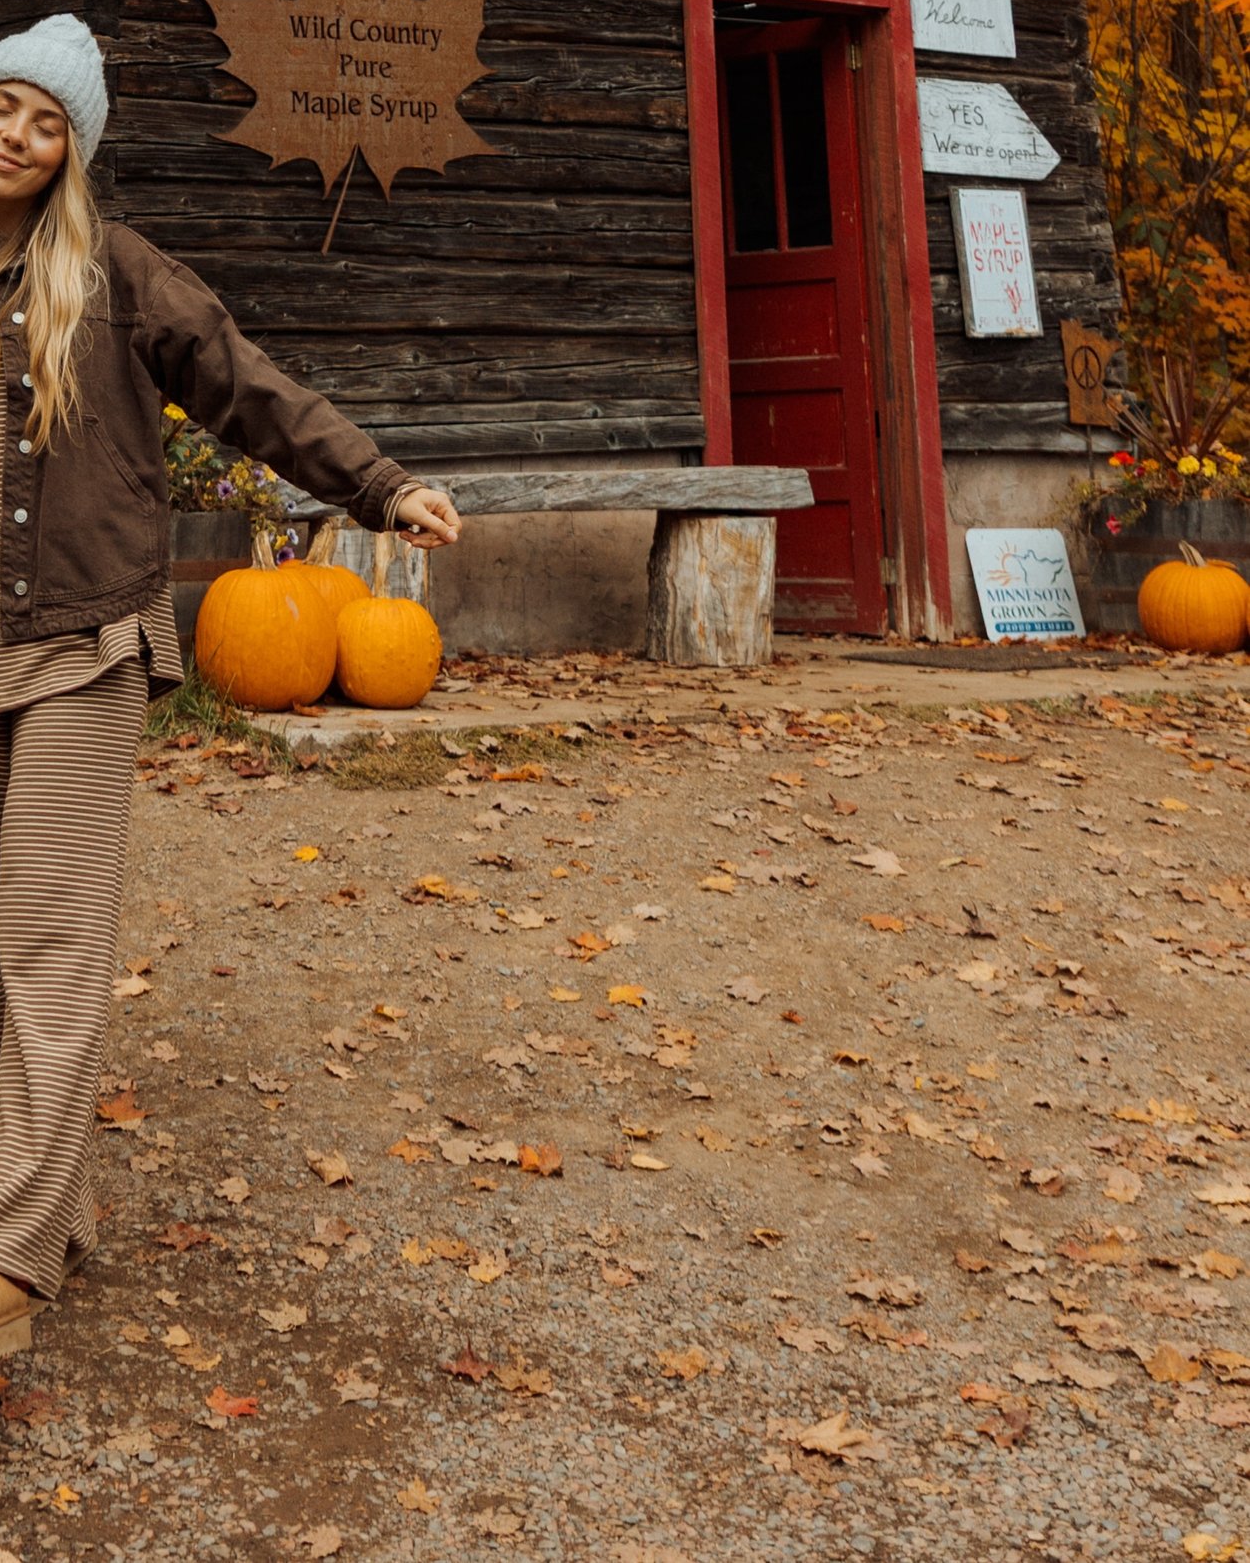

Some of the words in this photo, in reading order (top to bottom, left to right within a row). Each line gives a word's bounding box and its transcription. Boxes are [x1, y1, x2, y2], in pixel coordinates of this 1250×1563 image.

[289, 15, 341, 40] Wild
[349, 19, 442, 51] Country
[340, 53, 392, 78] Pure
[290, 90, 361, 121] Maple
[370, 93, 438, 124] Syrup
[933, 133, 960, 154] We
[964, 142, 994, 157] are
[969, 221, 1021, 245] MAPLE
[973, 248, 1023, 273] SYRUP
[986, 587, 1071, 602] MINNESOTA
[991, 604, 1047, 619] GROWN
[999, 622, 1032, 632] PROUD
